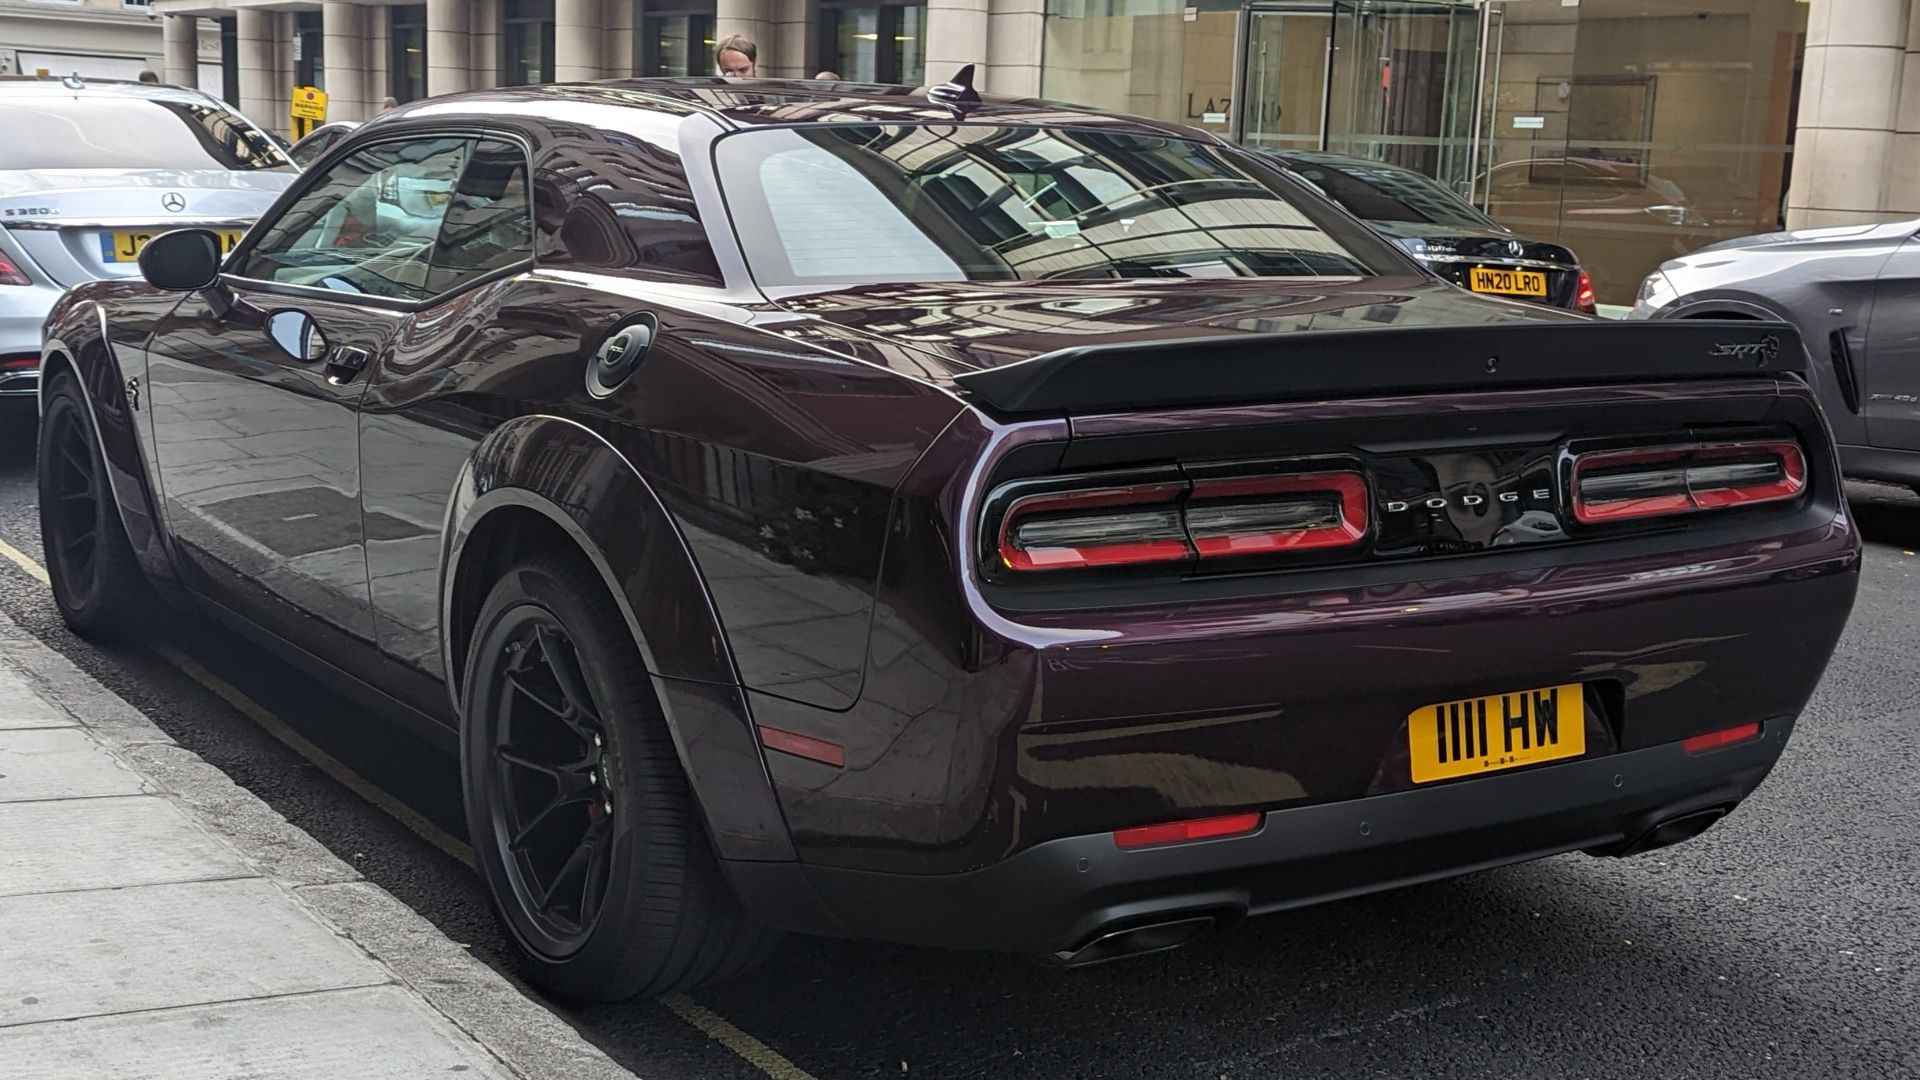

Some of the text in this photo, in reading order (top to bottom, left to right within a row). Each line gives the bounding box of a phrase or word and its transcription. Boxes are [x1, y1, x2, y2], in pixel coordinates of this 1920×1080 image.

[1475, 271, 1512, 290] HN20
[1387, 488, 1550, 512] DODGE
[1501, 687, 1558, 753] HW
